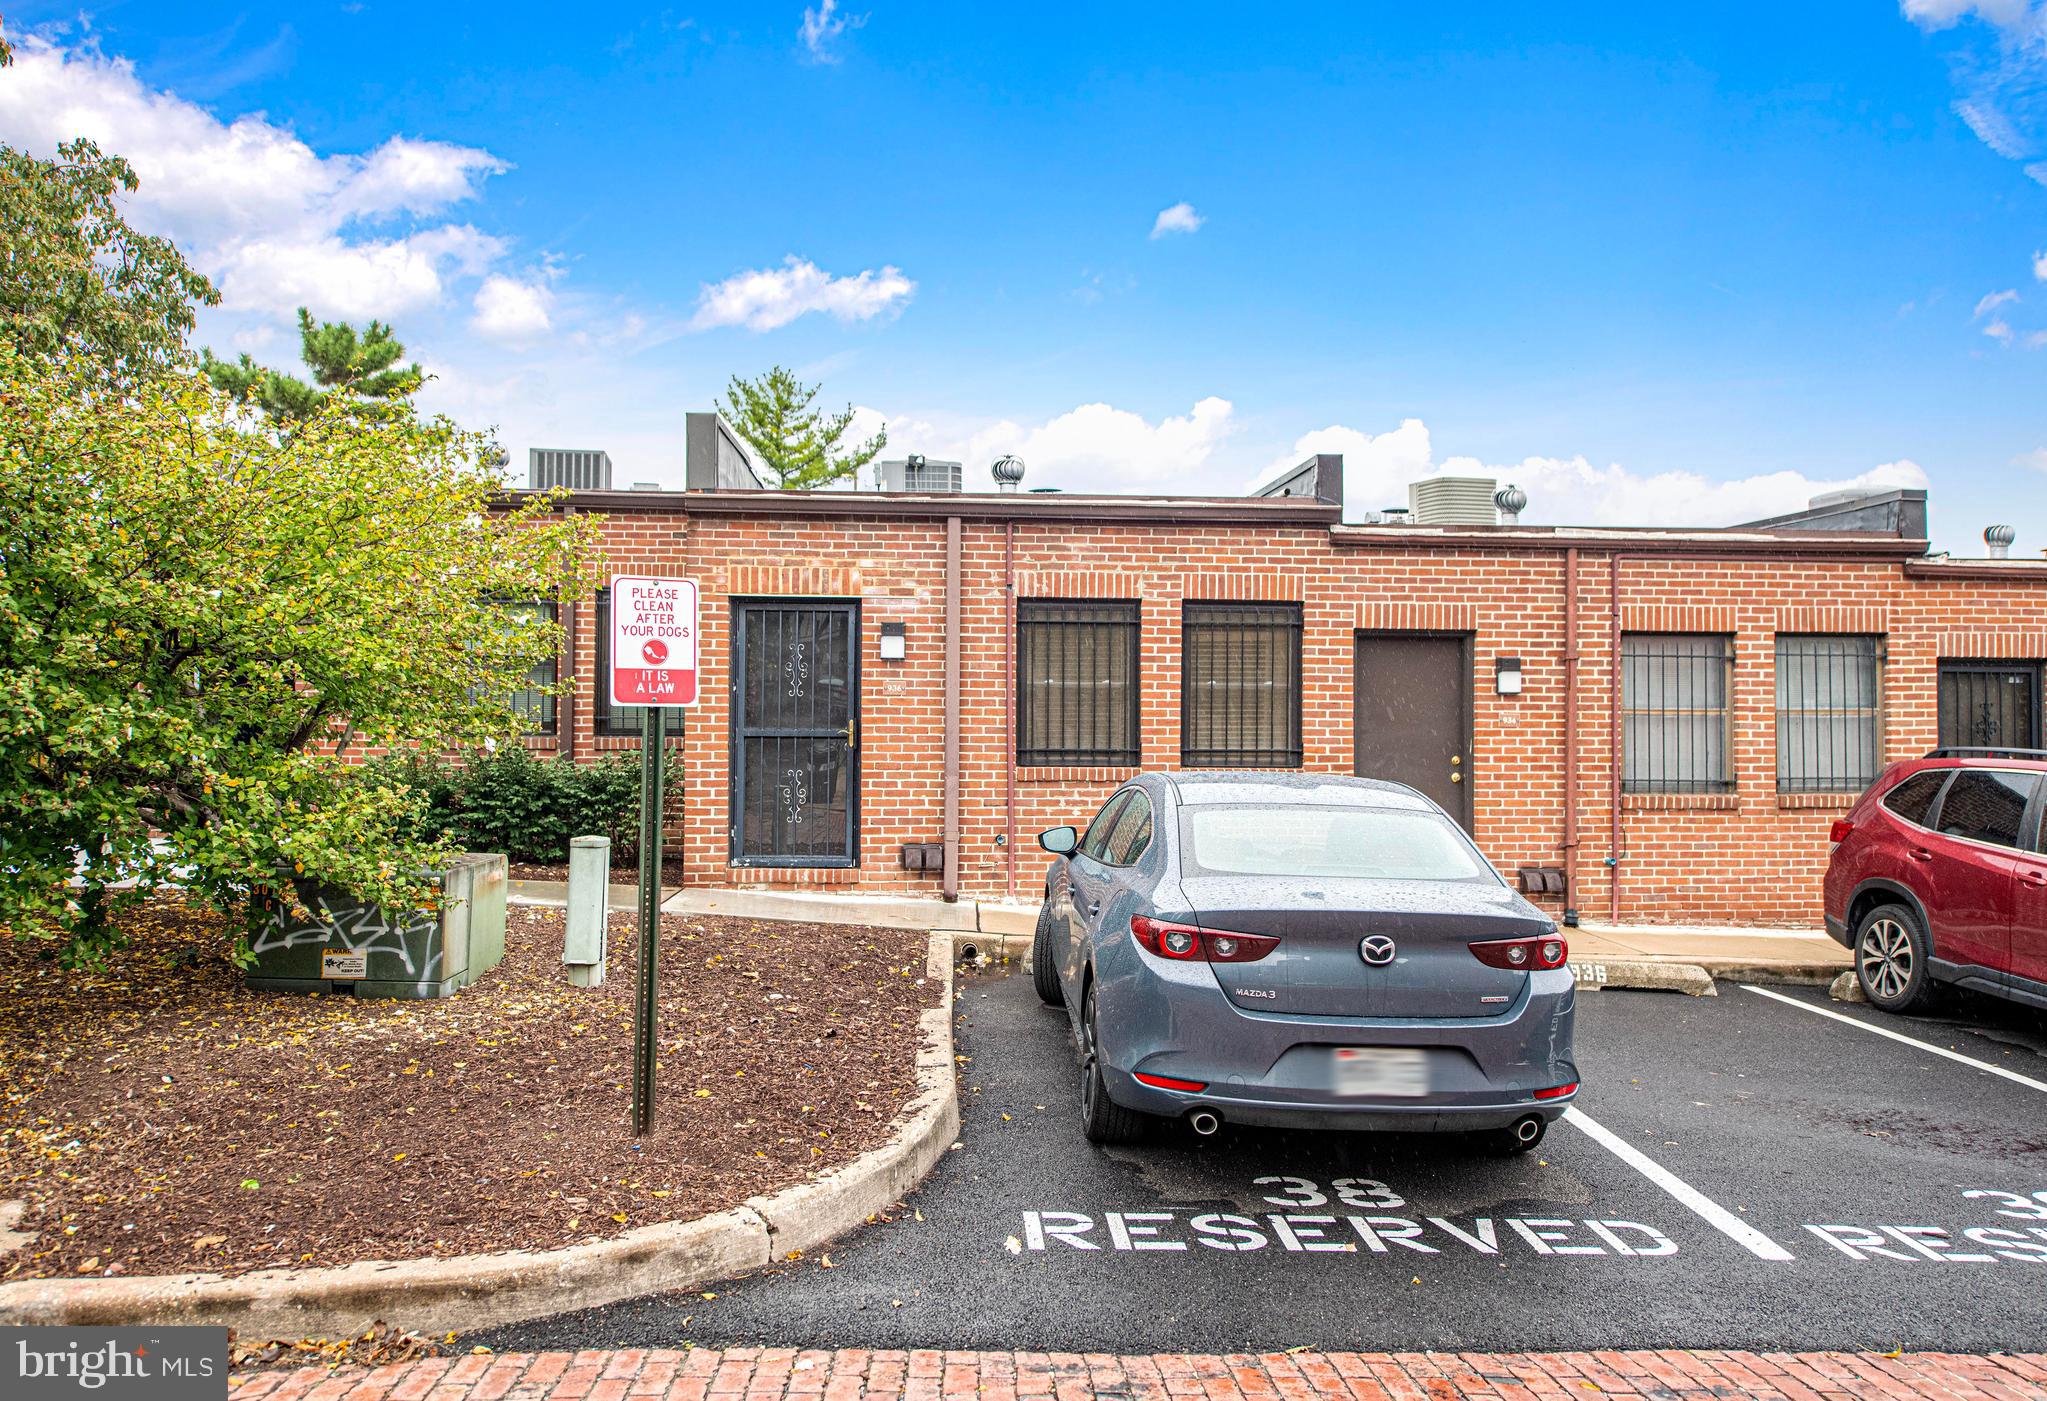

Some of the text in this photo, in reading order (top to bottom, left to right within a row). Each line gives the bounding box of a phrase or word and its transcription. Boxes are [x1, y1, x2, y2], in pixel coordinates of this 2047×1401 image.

[632, 588, 679, 600] PLEASE
[634, 600, 673, 612] CLEAN
[636, 613, 675, 624] AFTER
[621, 625, 690, 638] YOUR DOGS
[642, 670, 669, 681] IT IS
[636, 682, 675, 694] A LAW
[1252, 1174, 1406, 1209] 38
[1961, 1189, 2047, 1220] 3
[1022, 1209, 1680, 1257] RESERVED
